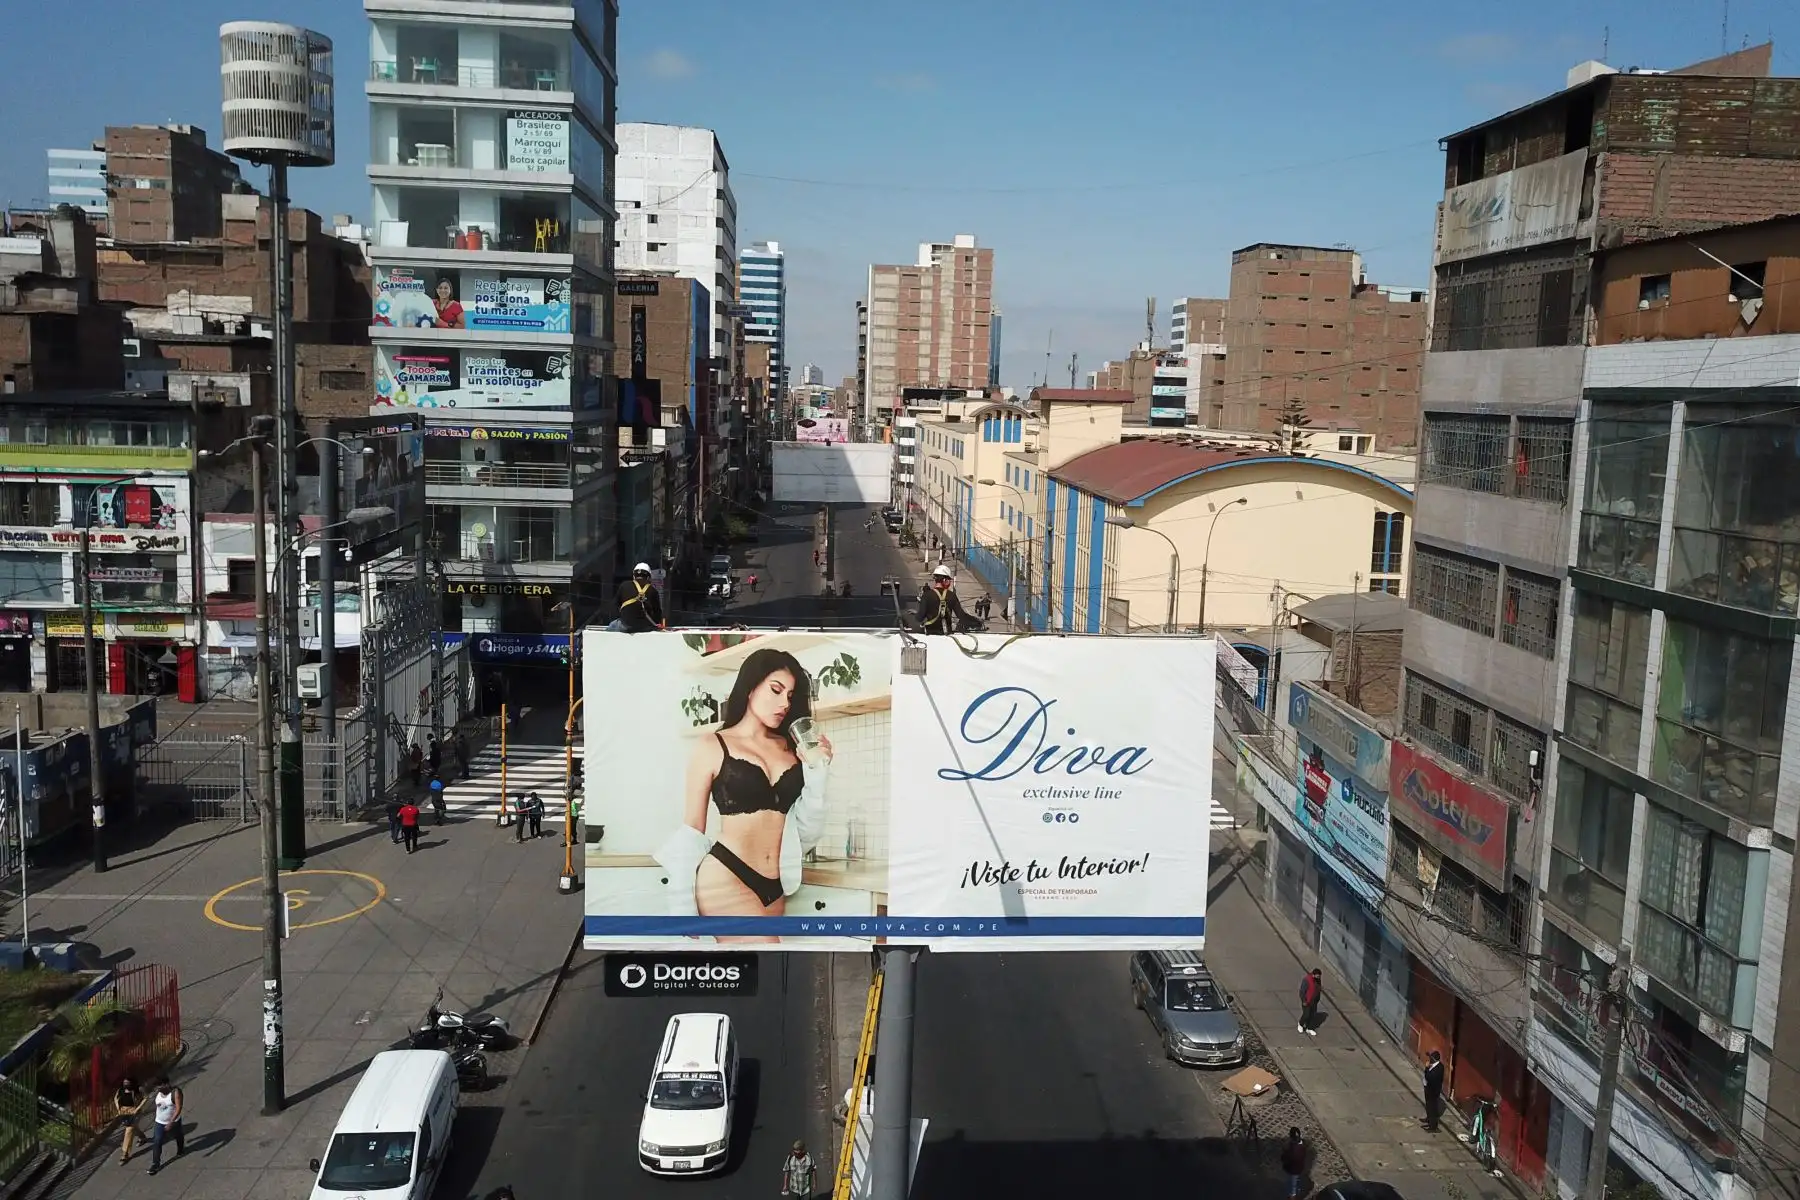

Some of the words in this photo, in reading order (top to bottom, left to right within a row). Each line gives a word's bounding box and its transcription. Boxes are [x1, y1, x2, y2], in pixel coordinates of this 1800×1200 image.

[514, 111, 561, 120] LACEADOS
[517, 120, 561, 130] Brasilero
[510, 155, 535, 164] Botox
[537, 157, 566, 166] capilar
[380, 281, 425, 291] GAMARRA
[474, 279, 522, 292] Registra
[524, 283, 531, 293] y
[619, 284, 656, 292] GALERIA
[475, 292, 530, 304] posiciona
[475, 305, 488, 315] tu
[490, 307, 528, 316] marca
[634, 312, 643, 363] PLAZA
[467, 357, 490, 365] Todos
[491, 358, 507, 366] tus
[406, 366, 436, 374] TODOS
[467, 364, 521, 377] Trámites
[522, 369, 534, 377] en
[398, 372, 451, 383] GAMARRA
[467, 377, 482, 385] un
[485, 377, 510, 386] solo
[512, 377, 544, 389] lugar
[490, 429, 523, 439] SAZÓN
[533, 431, 568, 440] PASIÓN
[91, 568, 161, 577] INTERNET
[447, 584, 465, 594] LA
[469, 584, 553, 595] CEBICHERA
[493, 642, 525, 655] Hogar
[527, 646, 534, 655] y
[937, 686, 1154, 781] Diva
[1022, 786, 1090, 799] exclusive
[1094, 786, 1123, 799] line
[960, 860, 1024, 889] ¡Viste
[1026, 859, 1052, 883] tu
[1057, 852, 1150, 880] Interior!
[653, 962, 741, 981] Dardos
[653, 982, 687, 990] Digital
